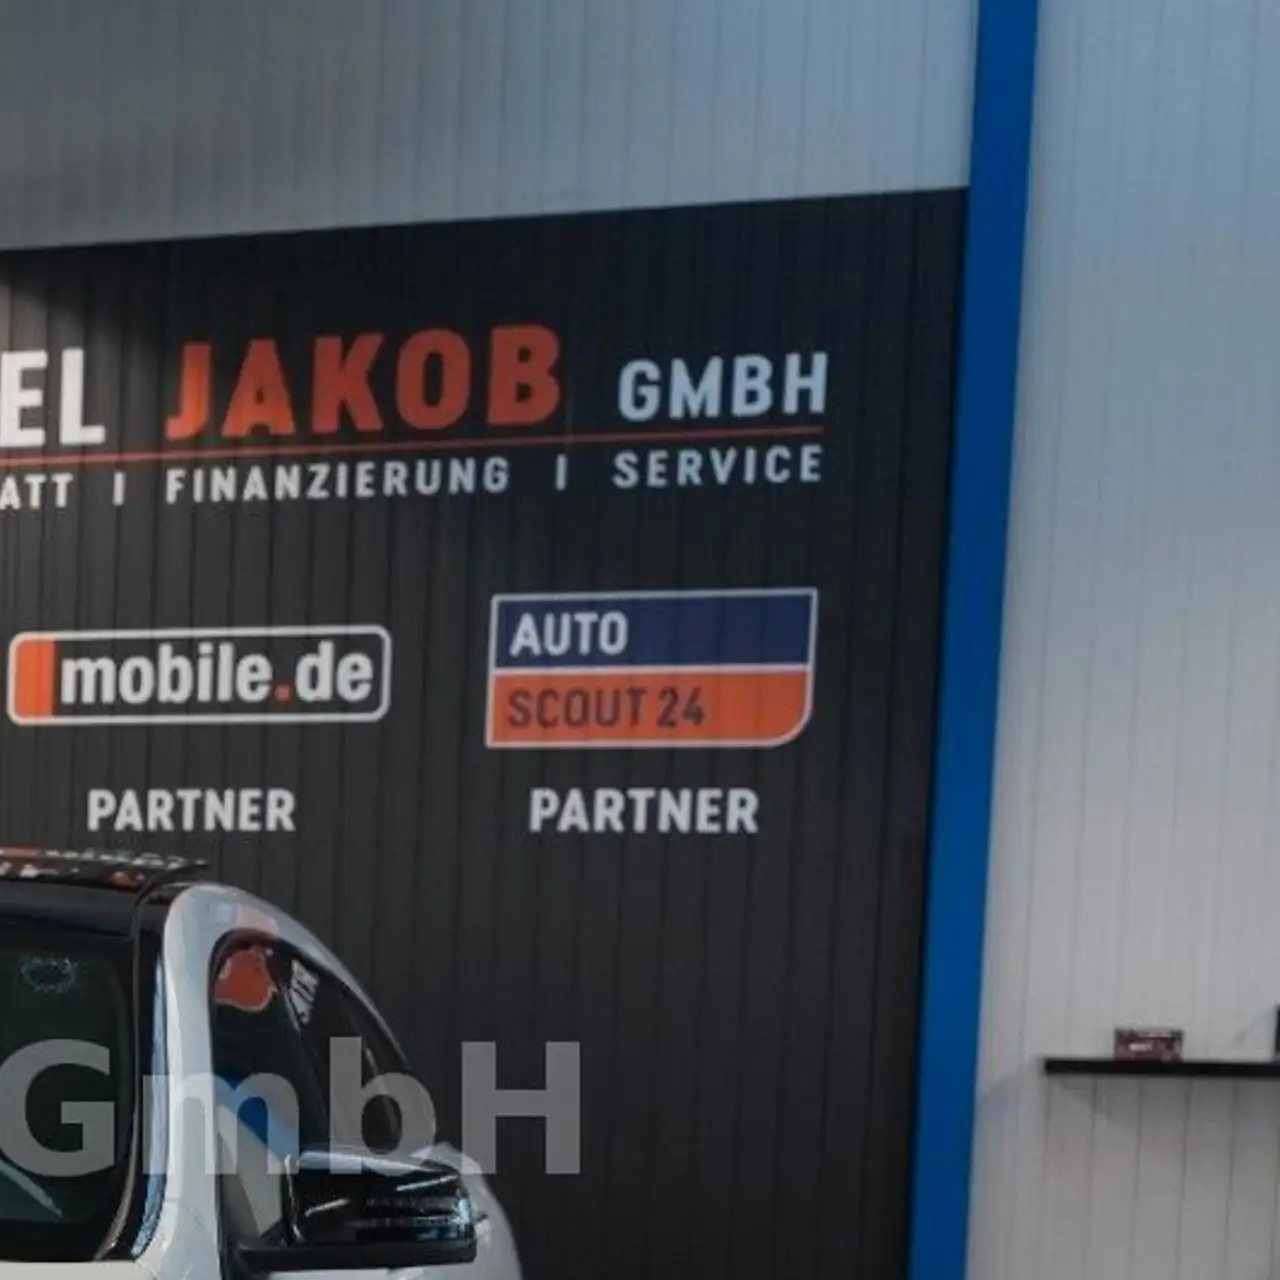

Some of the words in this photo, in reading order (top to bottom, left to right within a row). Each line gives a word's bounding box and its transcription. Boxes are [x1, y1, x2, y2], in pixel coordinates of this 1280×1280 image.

[165, 324, 562, 442] JAKOB
[618, 351, 828, 422] GMBH
[165, 457, 509, 505] FINANZIERUNG
[612, 445, 823, 489] SERVICE
[509, 611, 629, 657] AUTO
[58, 641, 374, 705] mobile.de
[507, 687, 647, 729] SCOUT
[656, 686, 706, 729] 24
[87, 788, 296, 832] PARTNER
[529, 788, 759, 833] PARTNER
